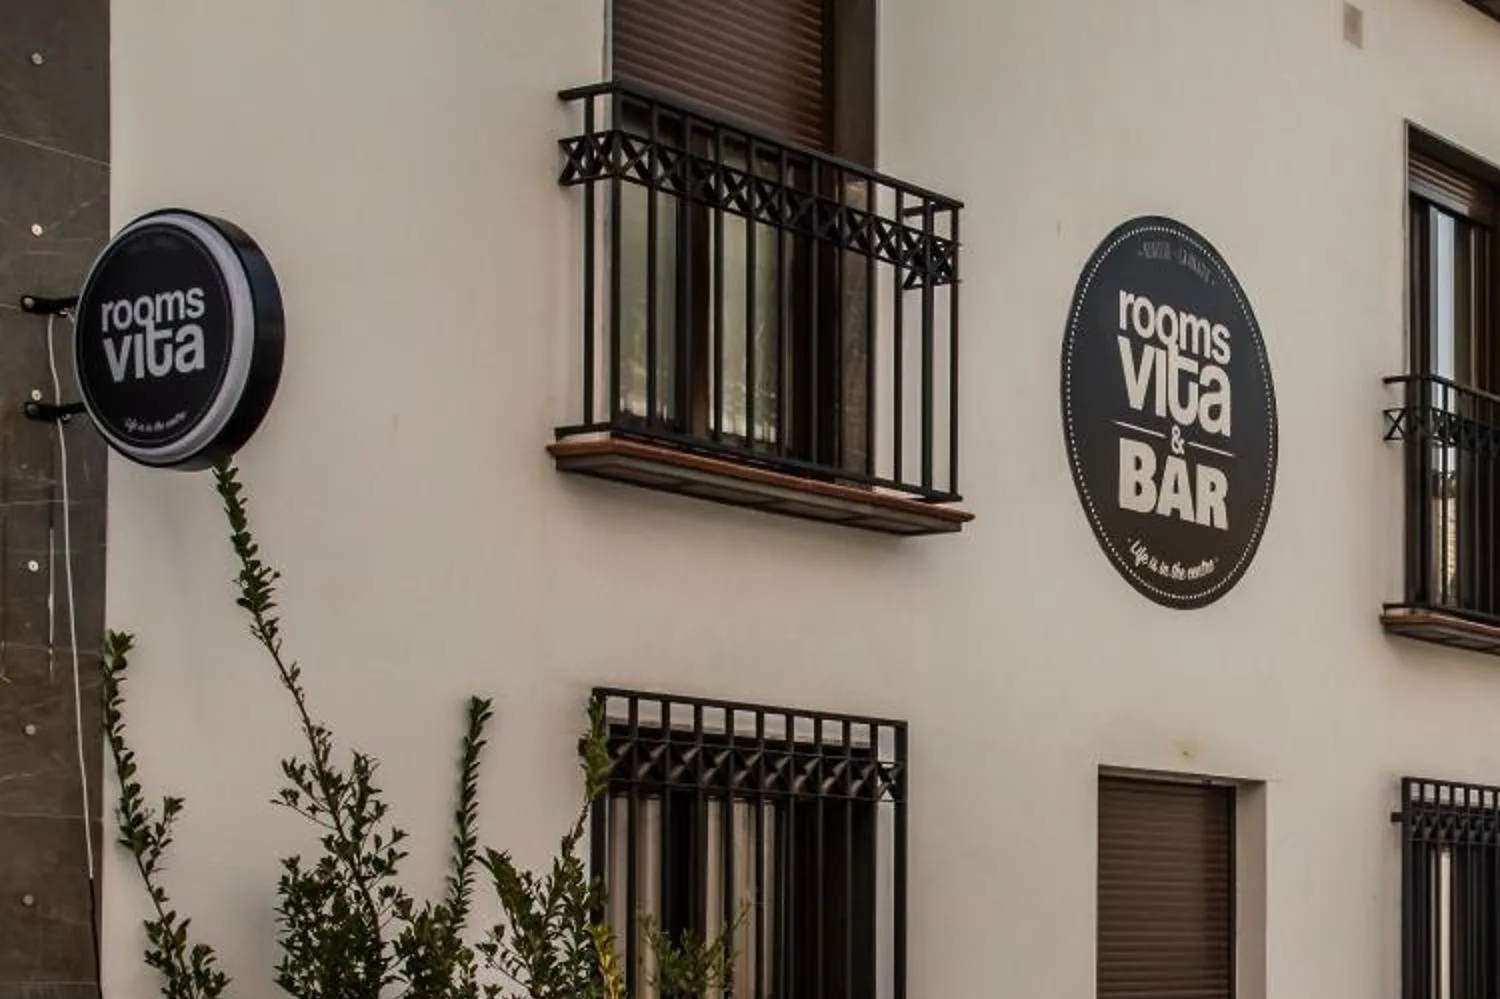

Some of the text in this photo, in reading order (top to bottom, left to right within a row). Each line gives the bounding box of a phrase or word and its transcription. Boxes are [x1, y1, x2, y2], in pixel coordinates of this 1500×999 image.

[101, 287, 205, 332] rooms
[1119, 289, 1231, 365] rooms
[102, 318, 205, 383] vita
[1117, 336, 1231, 437] vita
[1170, 426, 1185, 456] &
[1118, 438, 1230, 531] BAR
[1131, 538, 1148, 567] Life
[1171, 561, 1186, 581] the
